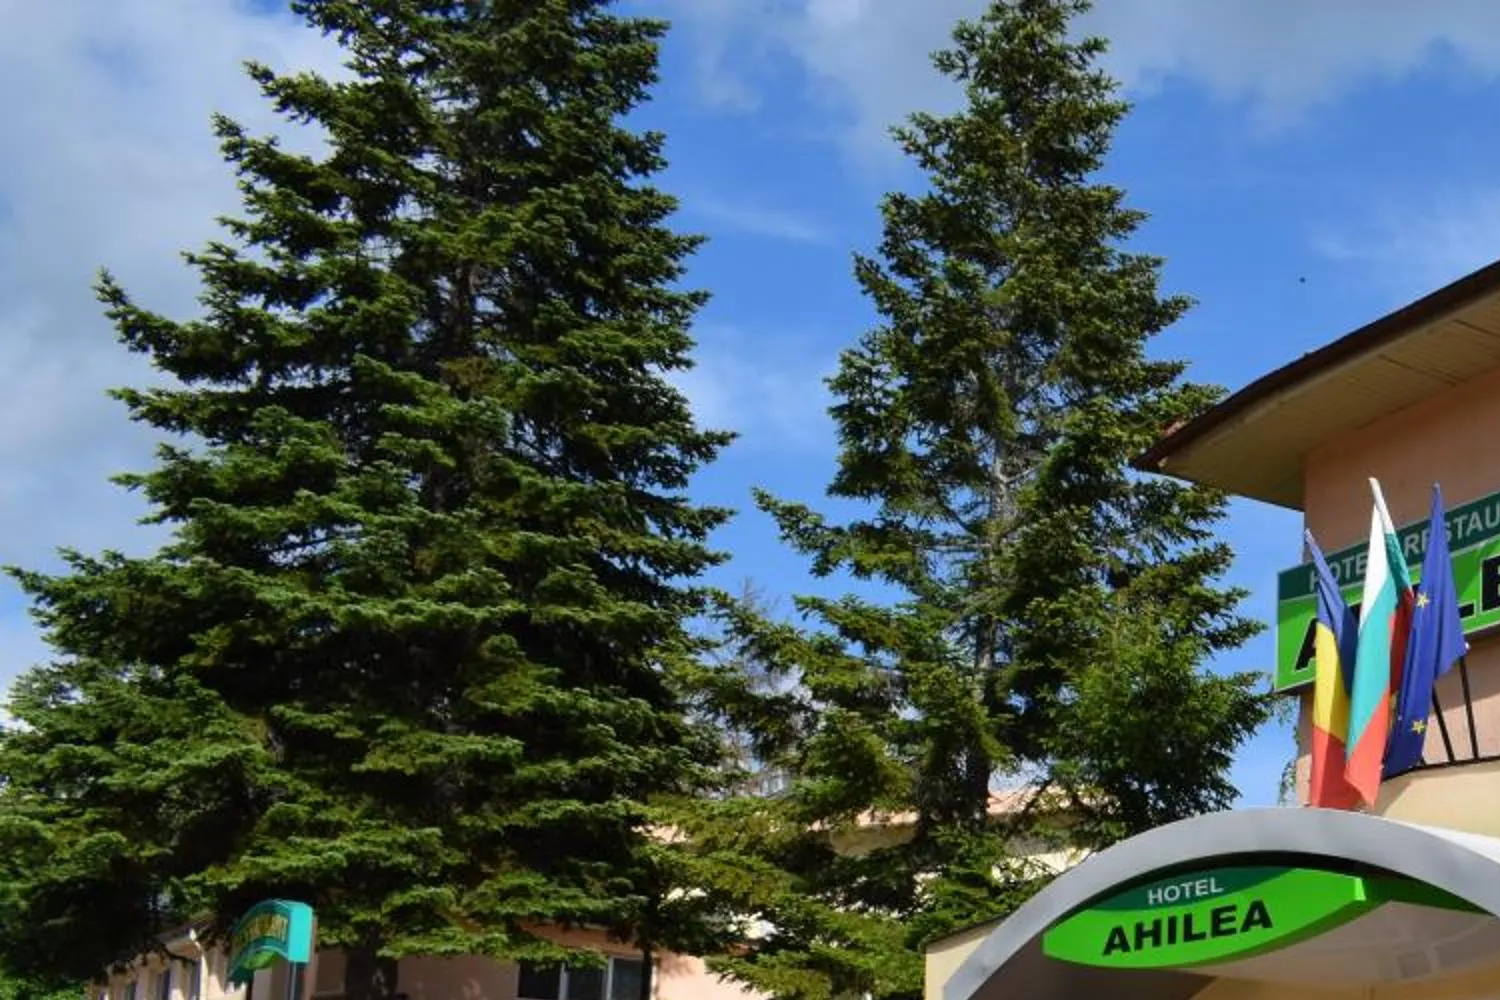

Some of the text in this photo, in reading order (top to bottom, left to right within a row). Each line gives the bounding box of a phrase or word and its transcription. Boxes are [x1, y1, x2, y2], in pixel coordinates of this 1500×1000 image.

[1309, 552, 1368, 592] HOTE
[1147, 877, 1224, 904] HOTEL
[1102, 900, 1273, 956] AHILEA
